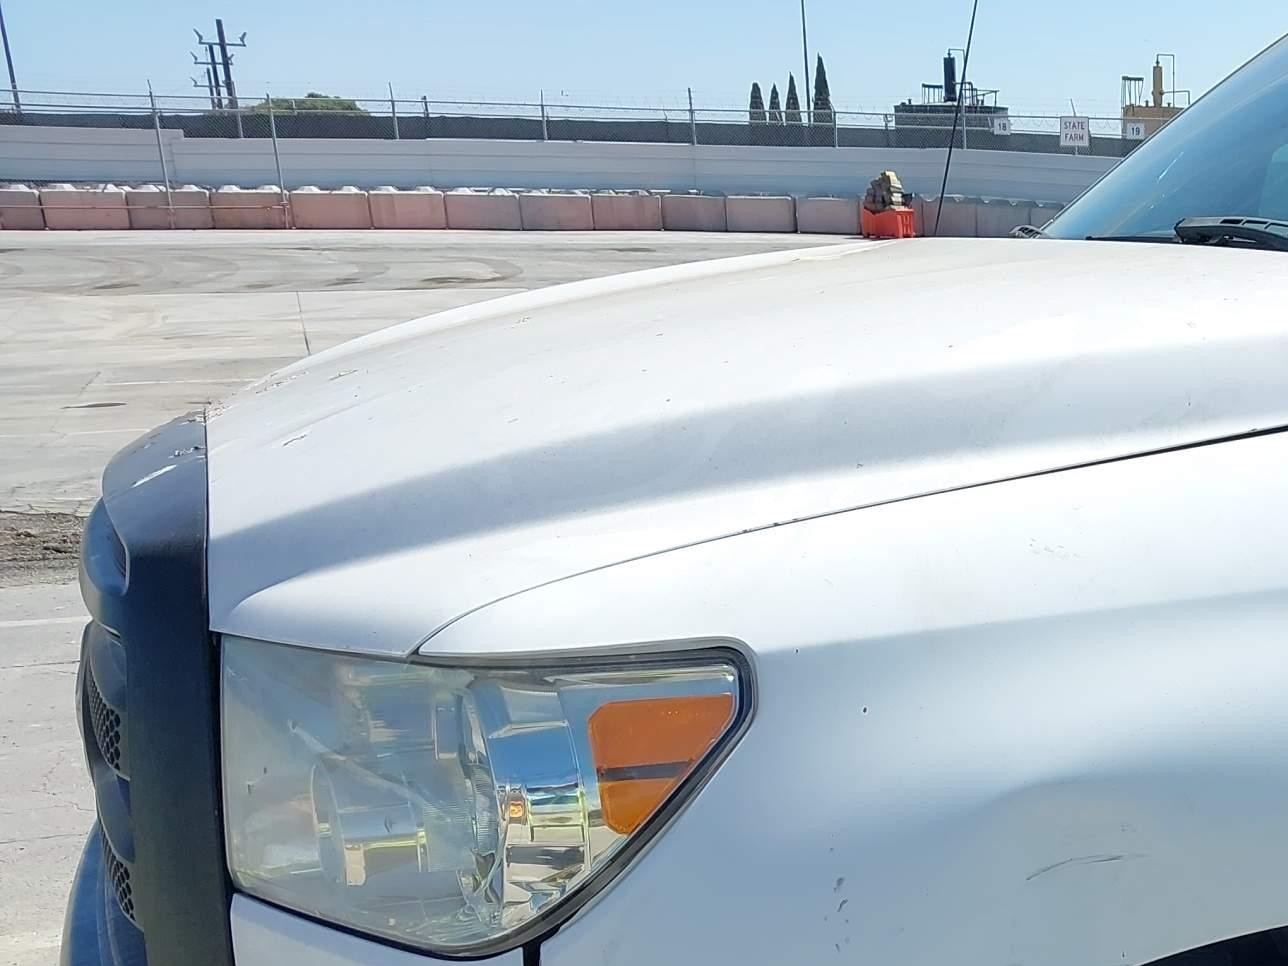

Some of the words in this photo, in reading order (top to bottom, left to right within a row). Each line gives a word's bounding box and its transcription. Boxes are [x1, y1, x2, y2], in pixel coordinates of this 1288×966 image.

[998, 122, 1007, 131] 18
[1063, 121, 1085, 130] STATE
[1131, 126, 1141, 136] 19
[1064, 132, 1084, 142] FARM
